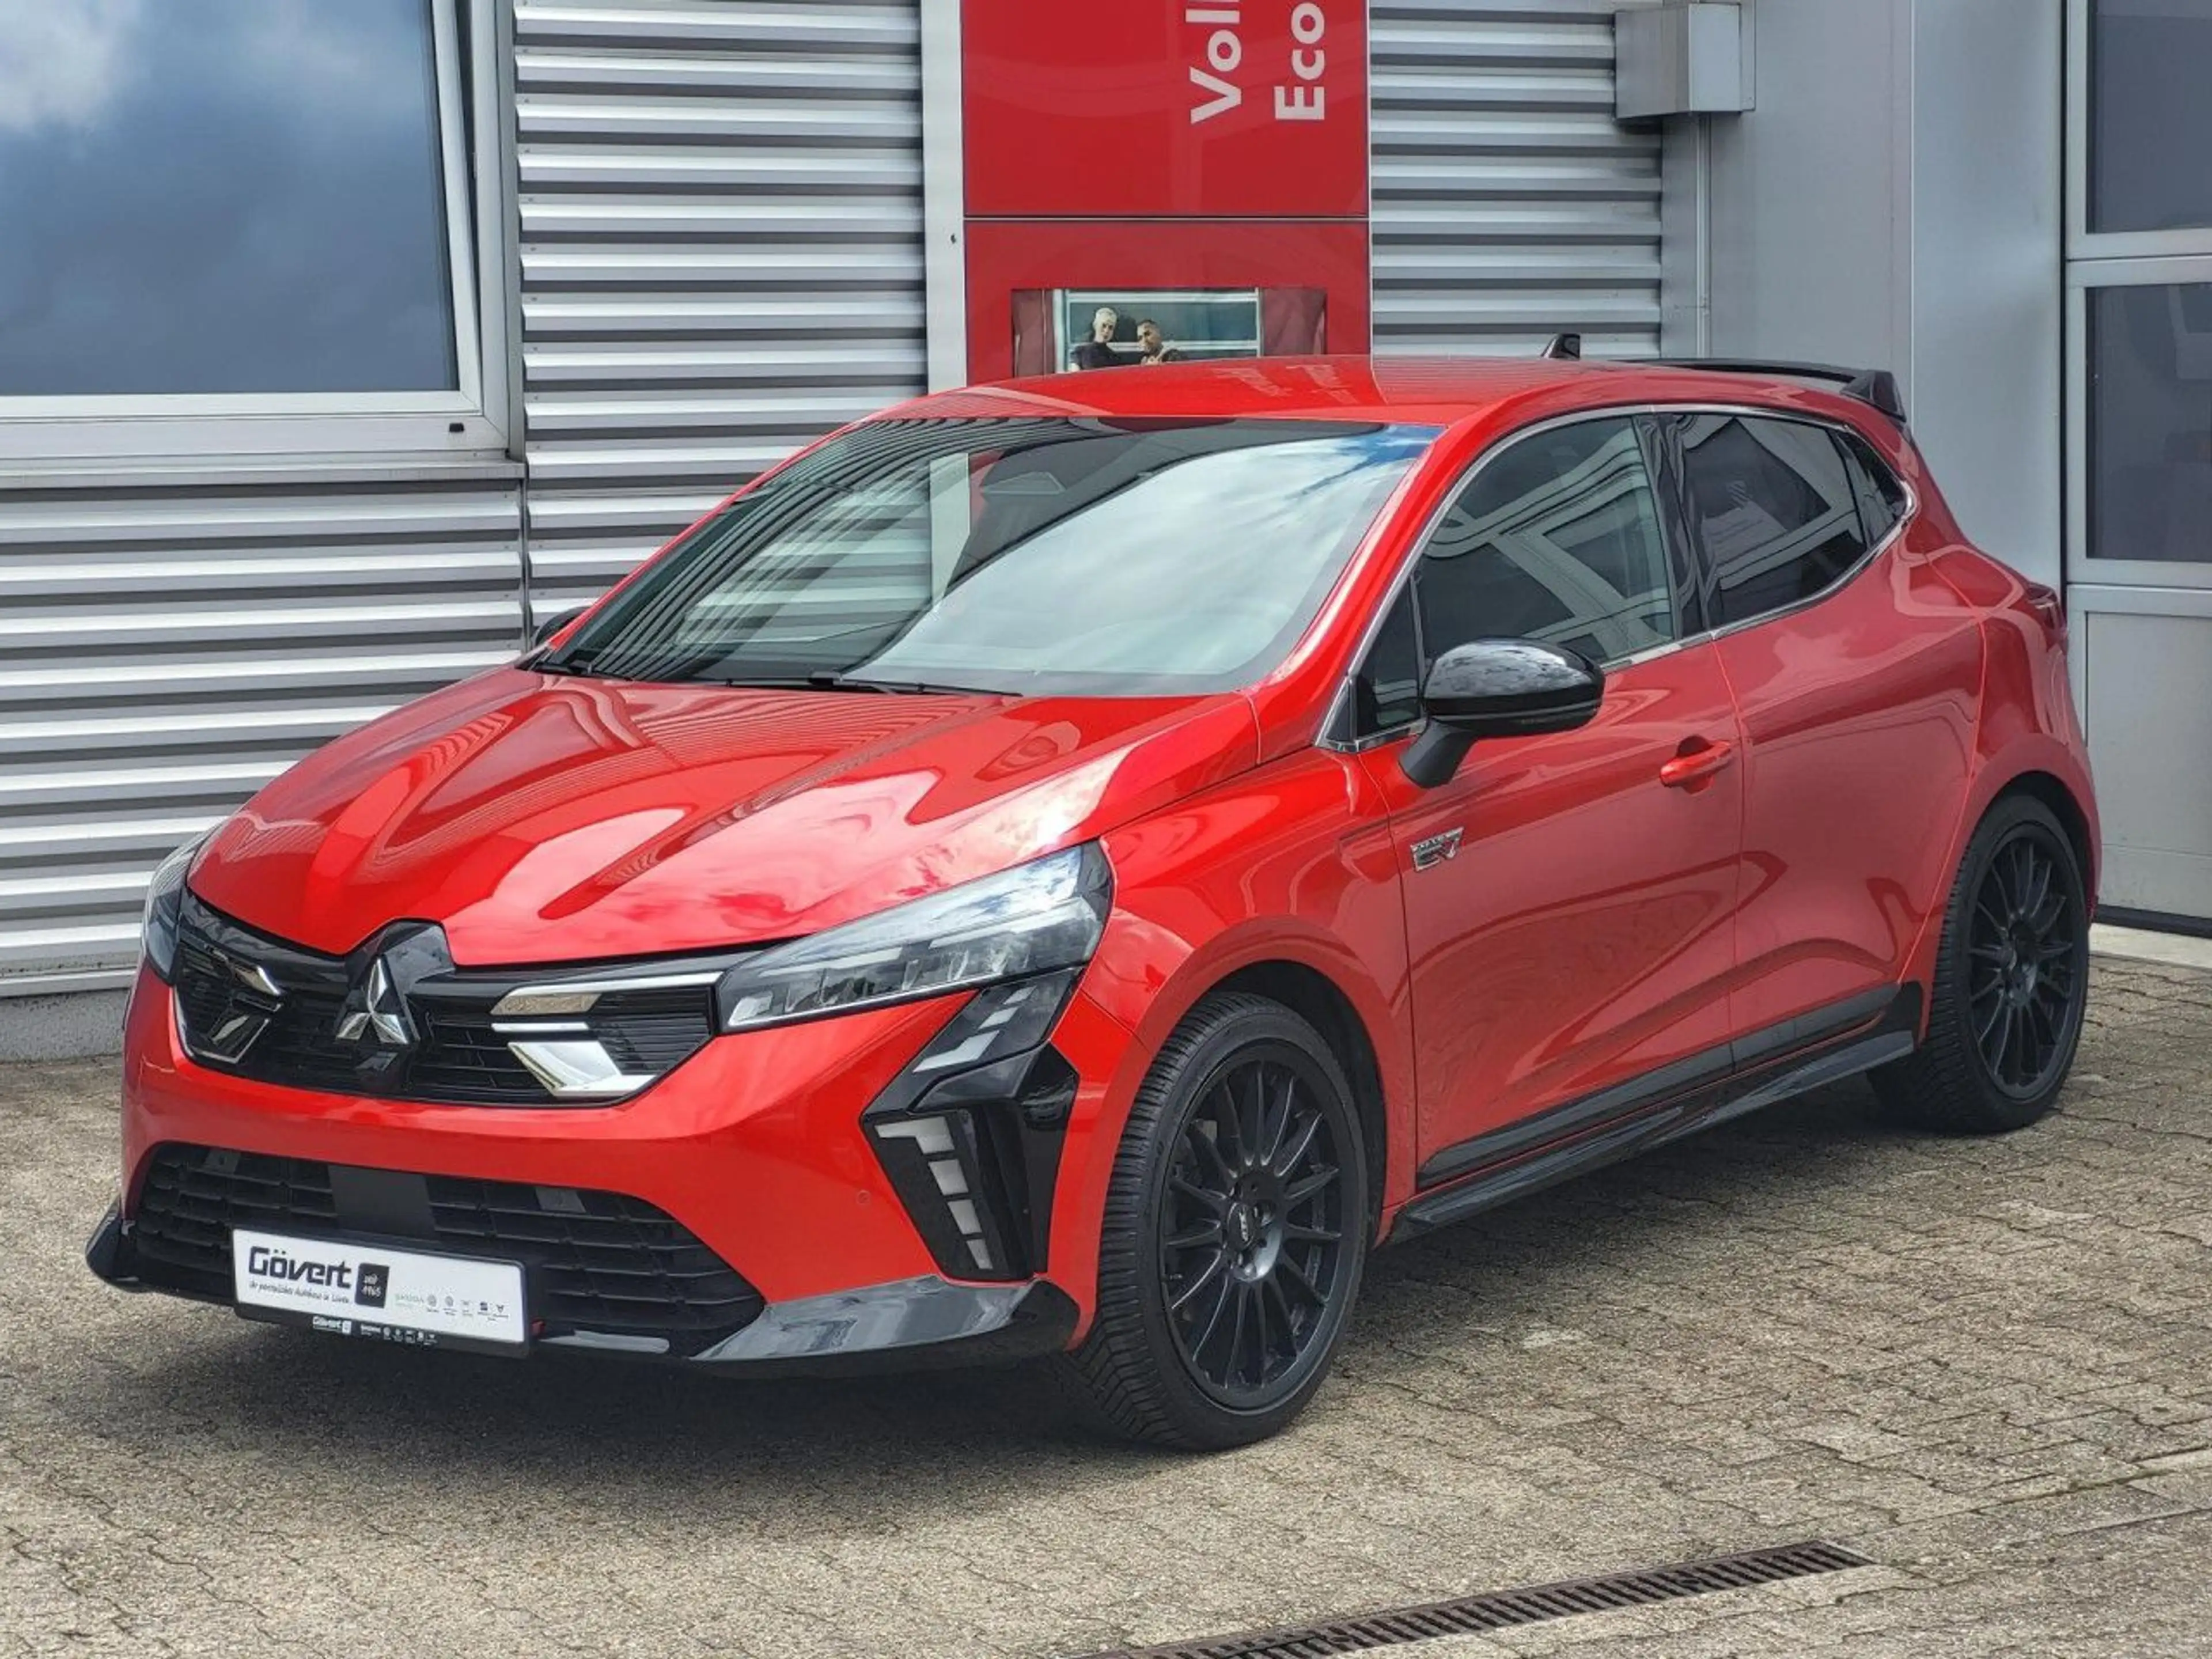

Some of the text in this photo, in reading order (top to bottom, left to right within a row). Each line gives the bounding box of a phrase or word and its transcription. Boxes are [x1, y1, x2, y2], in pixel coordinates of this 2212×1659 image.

[1185, 0, 1242, 124] Vol
[1274, 2, 1325, 120] Eco
[249, 1246, 351, 1288] Gövert
